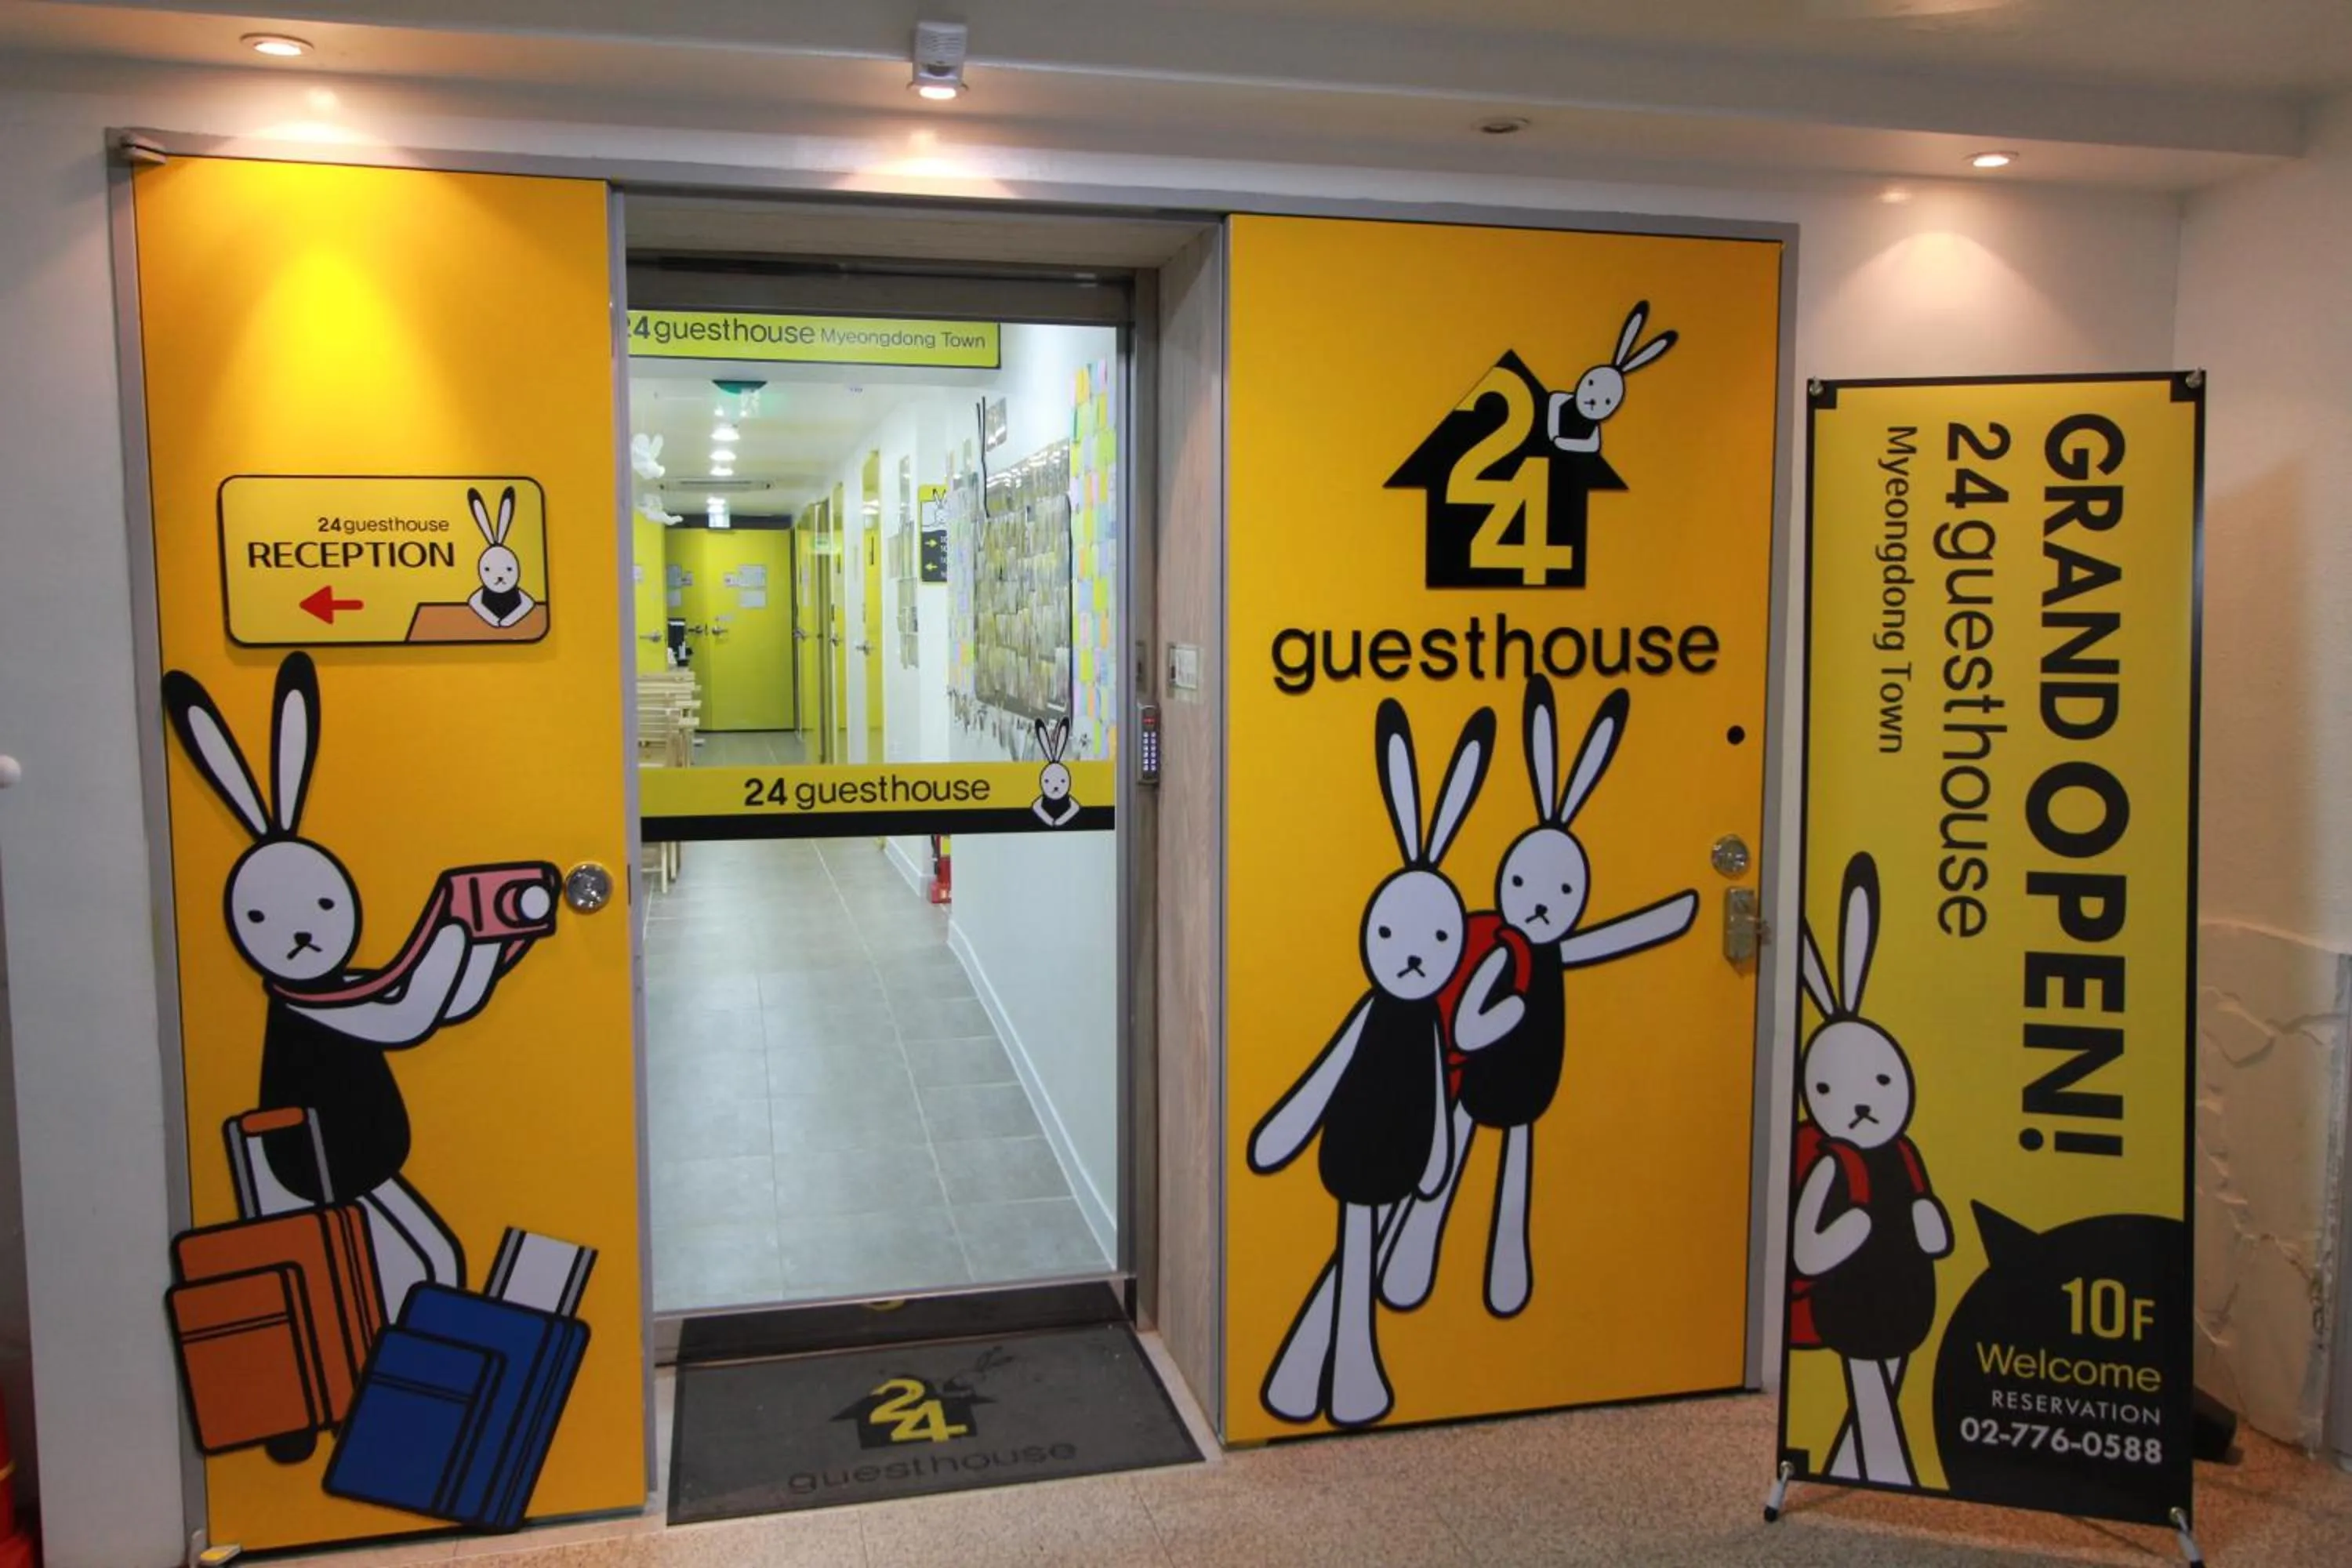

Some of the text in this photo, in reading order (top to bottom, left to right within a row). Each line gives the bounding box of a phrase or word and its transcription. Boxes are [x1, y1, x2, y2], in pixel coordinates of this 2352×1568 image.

[820, 328, 935, 348] Myeongdong
[942, 332, 985, 349] Town
[1445, 366, 1573, 586] 24
[248, 542, 455, 568] RECEPTION
[1873, 426, 1918, 754] Myeongdong Town
[1271, 612, 1720, 695] guesthouse
[2018, 413, 2130, 1157] GRAND OPEN!
[1976, 1341, 2161, 1392] Welcome
[869, 1379, 967, 1443] 24
[1991, 1391, 2160, 1425] RESERVATION
[1960, 1417, 2162, 1463] 02-776-0588
[788, 1442, 1077, 1492] guesthouse
